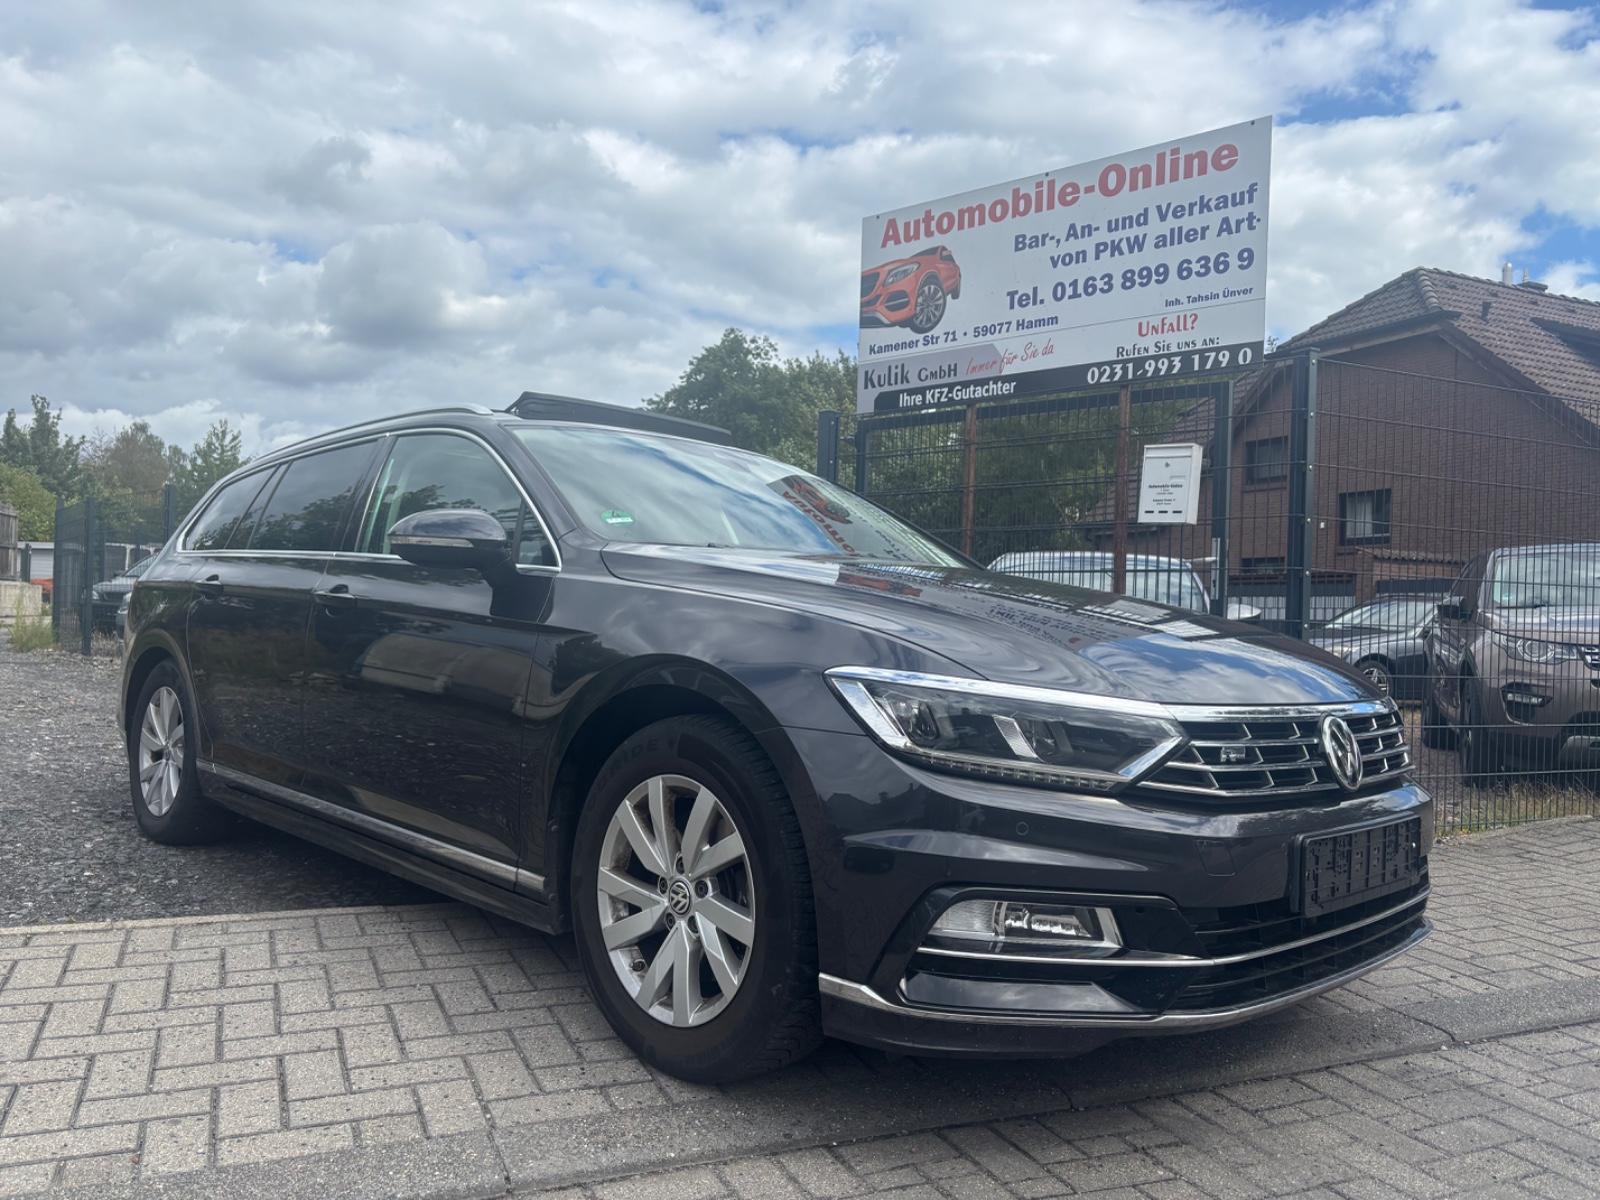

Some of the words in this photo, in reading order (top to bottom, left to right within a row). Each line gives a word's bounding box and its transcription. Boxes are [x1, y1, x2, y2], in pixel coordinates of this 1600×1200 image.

[880, 143, 1239, 248] Automobile-Online
[1014, 233, 1061, 252] Bar-,
[1065, 223, 1100, 242] An-
[1107, 207, 1149, 233] und
[1156, 182, 1258, 222] Verkauf
[1049, 249, 1087, 268] von
[1094, 233, 1147, 261] PKW
[1154, 224, 1210, 250] aller
[1006, 286, 1045, 310] Tel.
[1052, 272, 1114, 302] 0163
[1121, 262, 1170, 291] 899
[1177, 251, 1230, 281] 636
[1237, 247, 1255, 270] 9
[1165, 298, 1184, 308] Inh.
[1186, 292, 1220, 305] Tahsin
[1222, 287, 1254, 299] Ünver
[869, 338, 920, 356] Kamener
[922, 335, 941, 347] Str
[944, 331, 959, 343] 71
[973, 321, 1012, 338] 59077
[1016, 315, 1059, 331] Hamm
[1020, 341, 1040, 363] Sie
[1041, 335, 1056, 356] da
[863, 362, 911, 390] Kulik
[1191, 350, 1231, 371] 179
[1237, 347, 1253, 366] 0
[899, 392, 923, 408] Ihre
[925, 380, 1018, 405] KFZ-Gutachter
